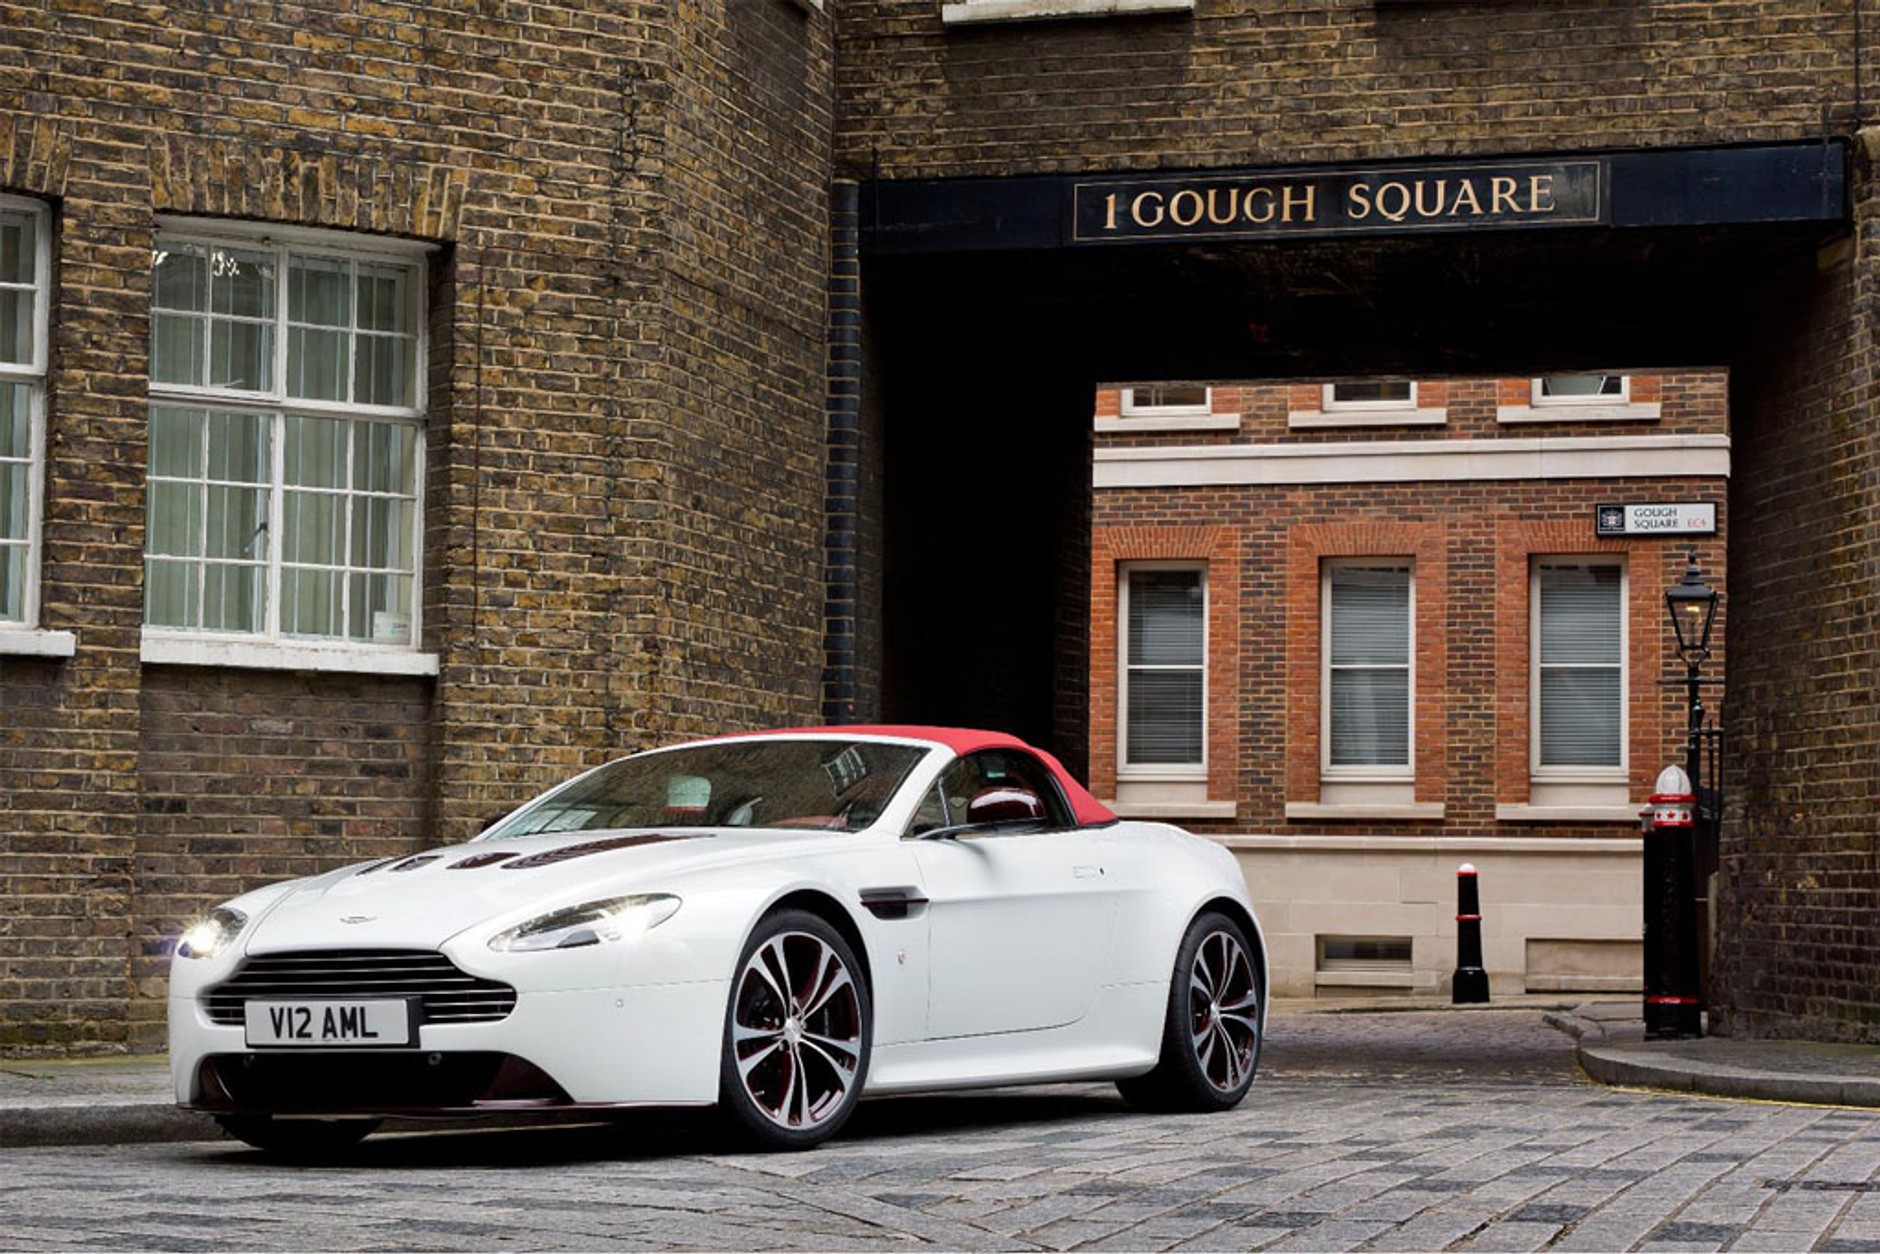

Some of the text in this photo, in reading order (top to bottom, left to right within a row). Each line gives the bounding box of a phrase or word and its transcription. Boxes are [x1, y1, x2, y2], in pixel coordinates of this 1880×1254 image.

[1103, 174, 1556, 229] 1 GOUGH SQUARE
[1634, 508, 1677, 517] GOUGH
[1634, 519, 1678, 529] SQUARE
[269, 1006, 378, 1038] V12 AML
